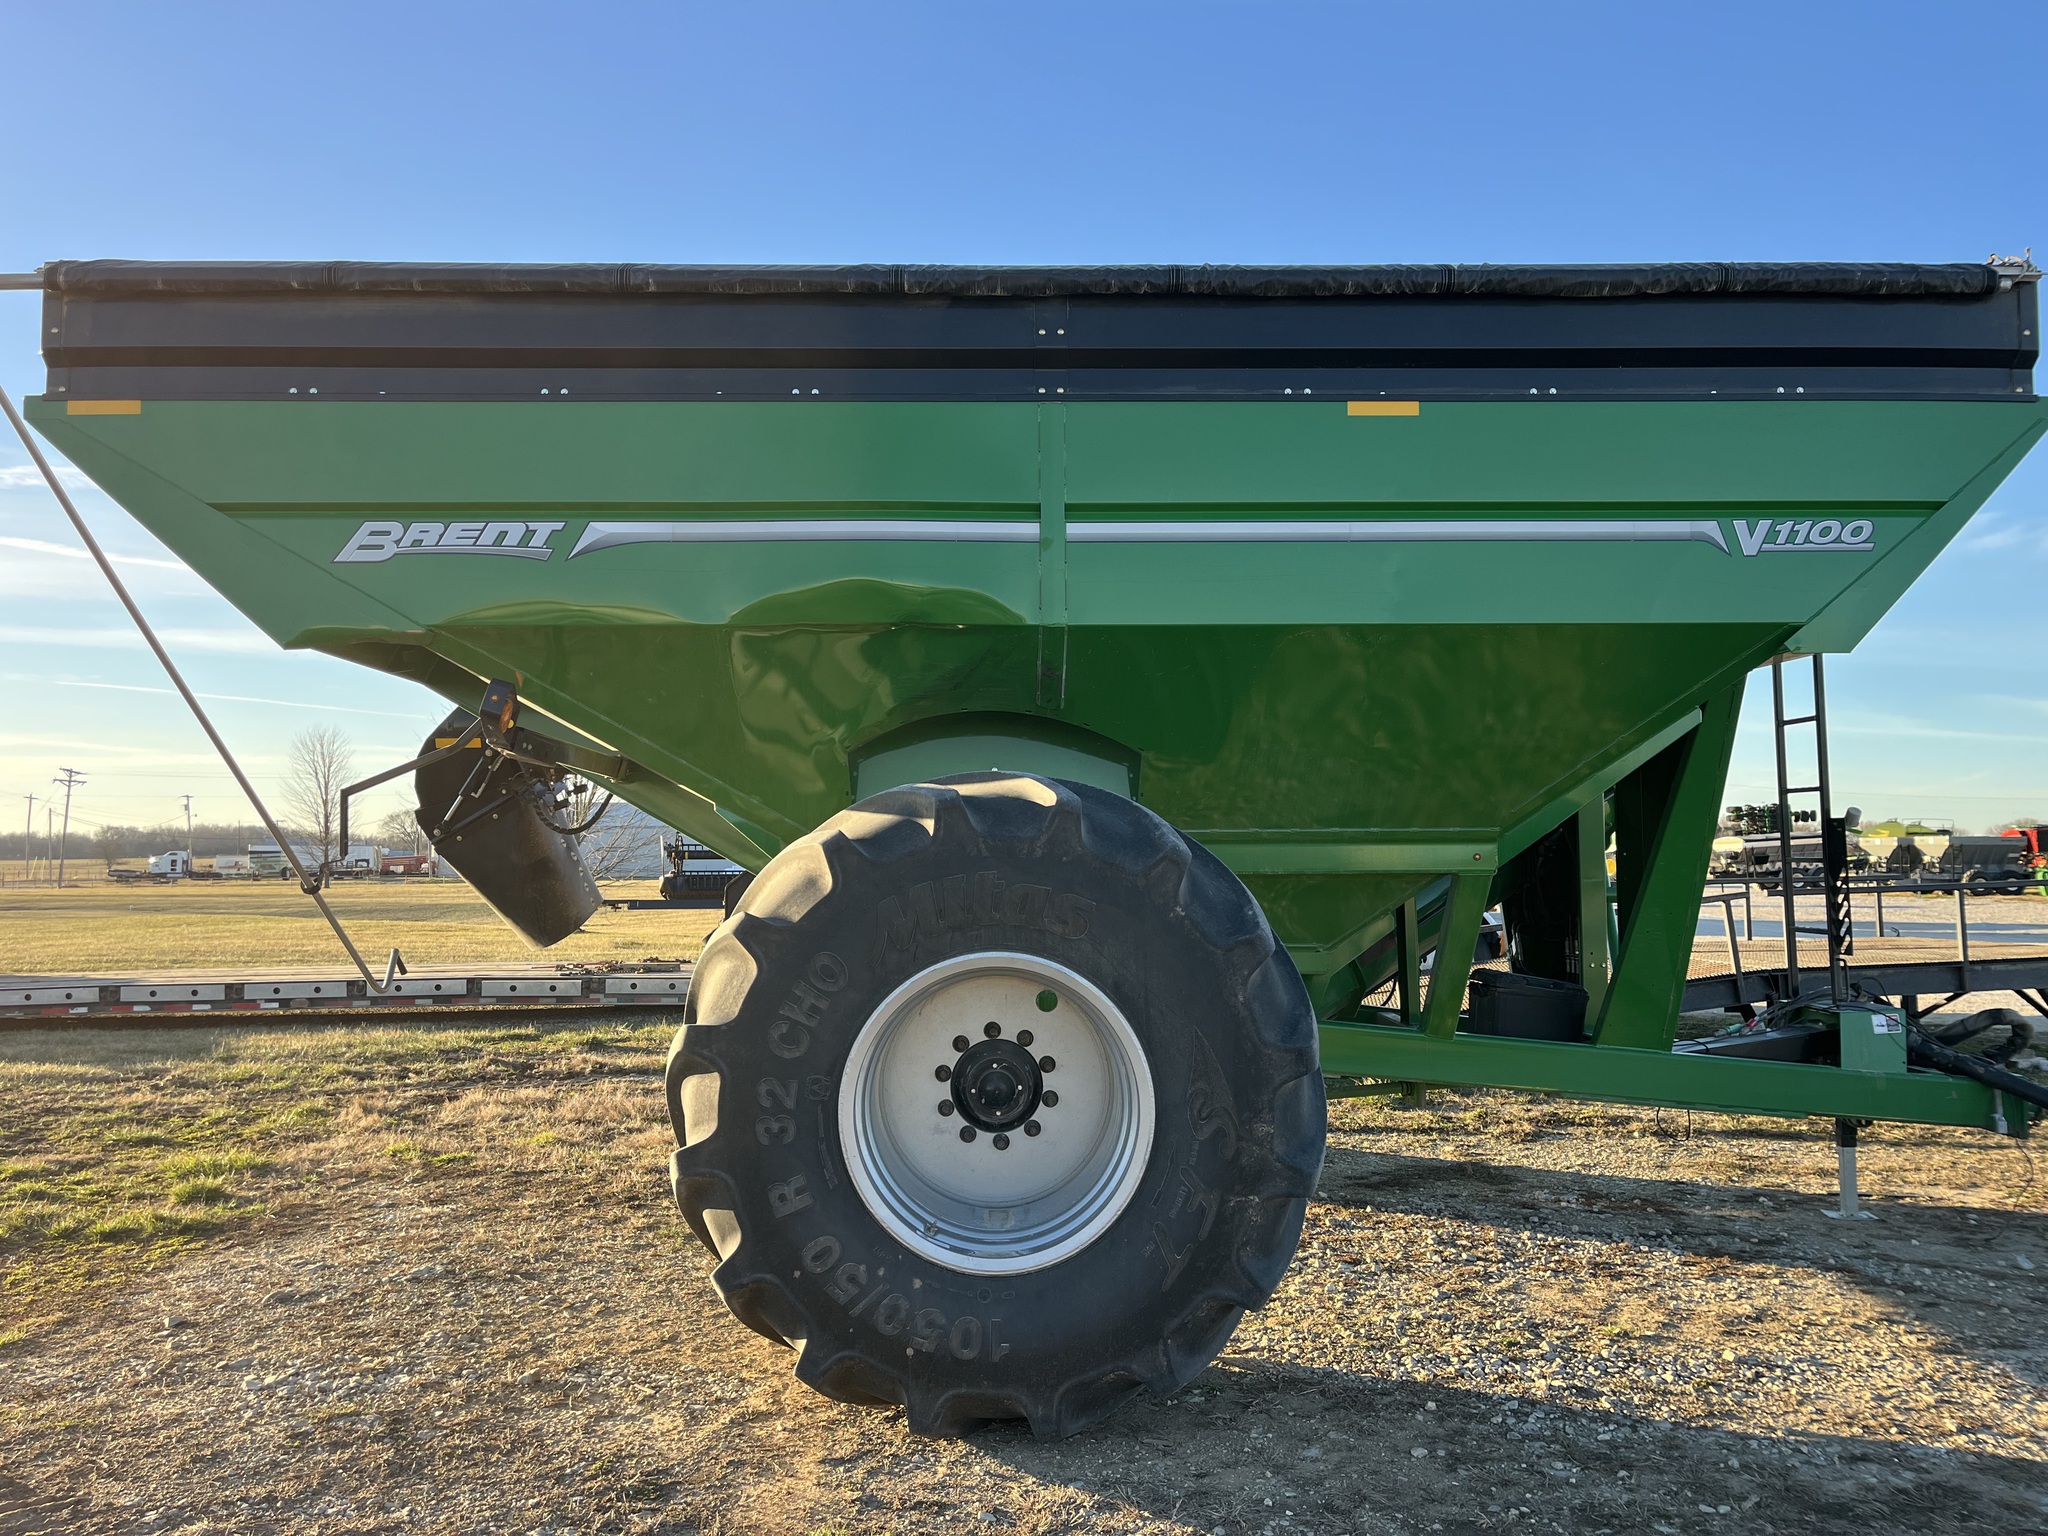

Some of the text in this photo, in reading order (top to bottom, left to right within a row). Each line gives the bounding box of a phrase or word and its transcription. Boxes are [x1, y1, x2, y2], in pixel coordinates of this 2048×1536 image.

[331, 520, 567, 563] BRENT
[874, 870, 1097, 968] Mitas
[755, 951, 1010, 1363] 1050/50 R 32 CHO
